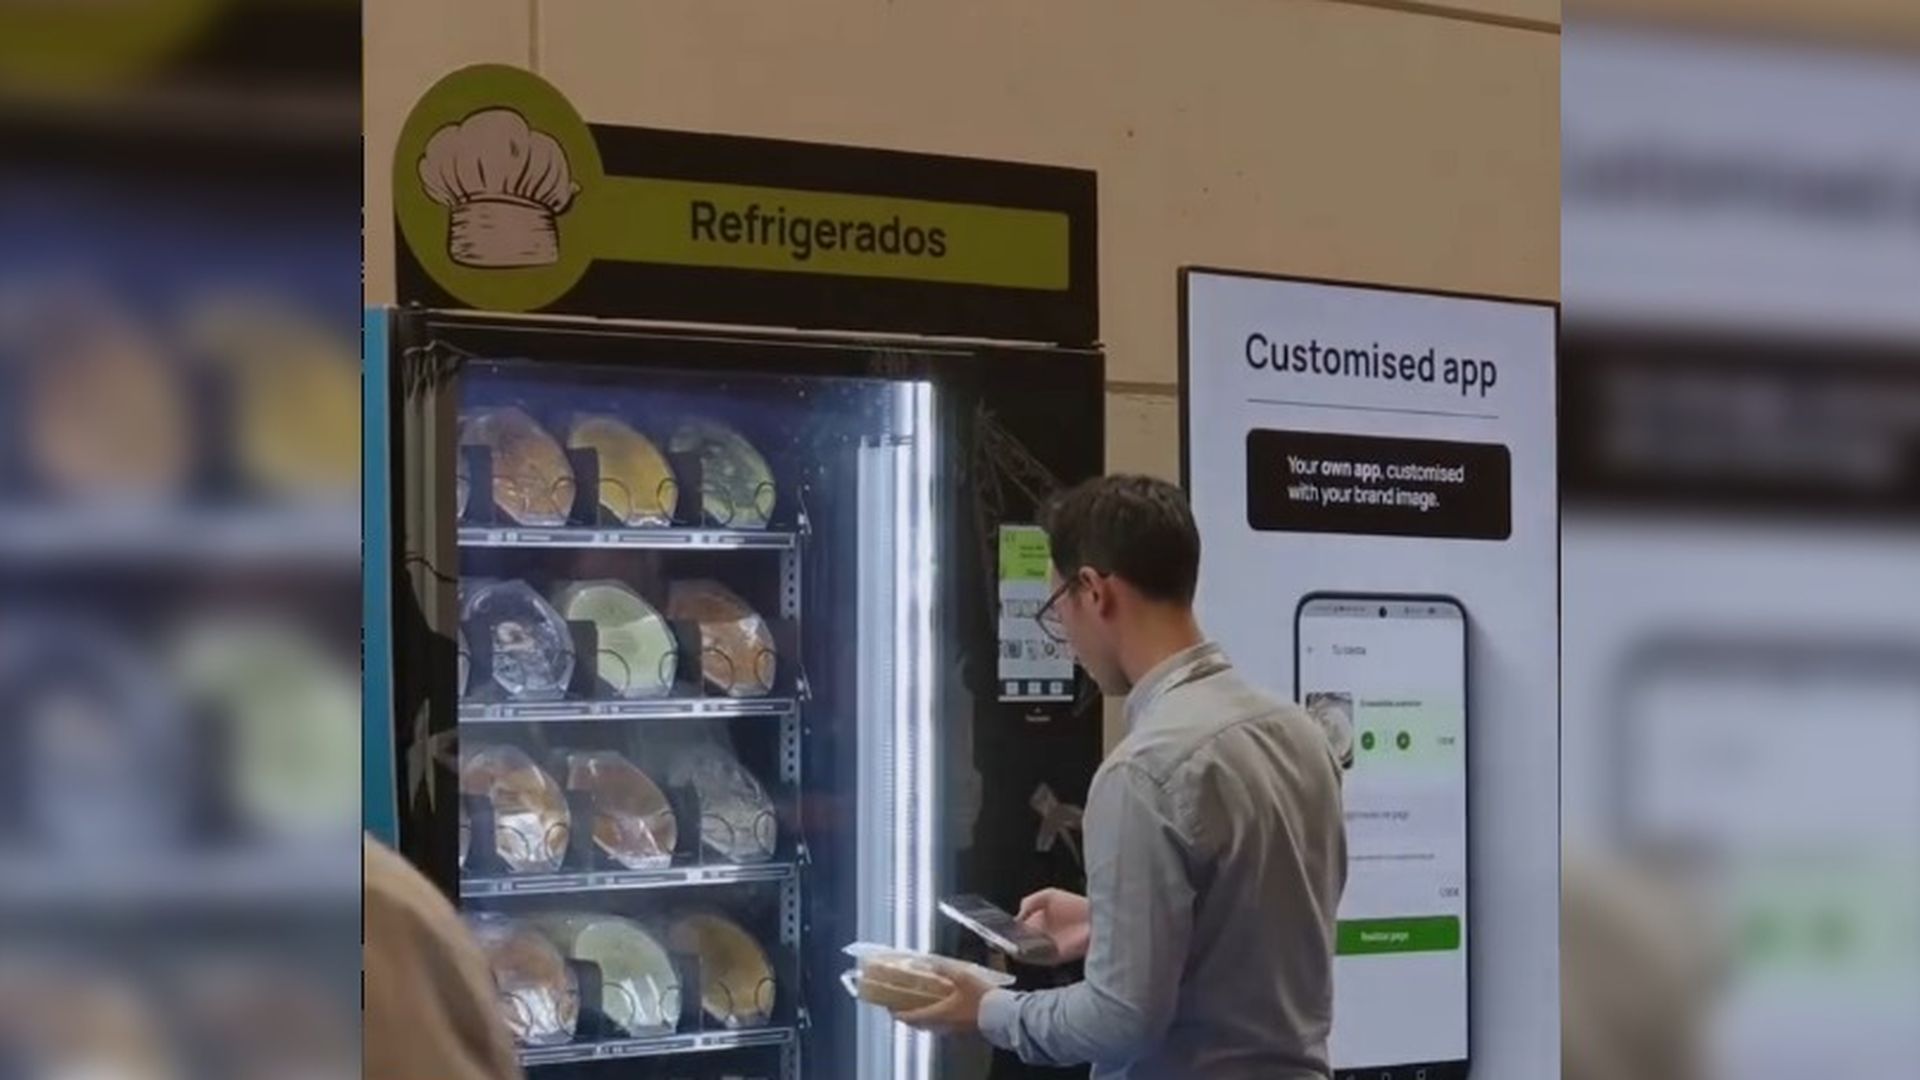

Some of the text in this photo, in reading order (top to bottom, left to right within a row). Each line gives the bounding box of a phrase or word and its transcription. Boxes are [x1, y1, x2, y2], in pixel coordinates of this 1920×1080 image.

[691, 201, 947, 260] Refrigerados
[1246, 333, 1497, 397] Customised app
[1288, 456, 1319, 474] Your
[1321, 461, 1352, 477] own
[1386, 465, 1464, 483] customised
[1287, 483, 1440, 512] with your brand image.
